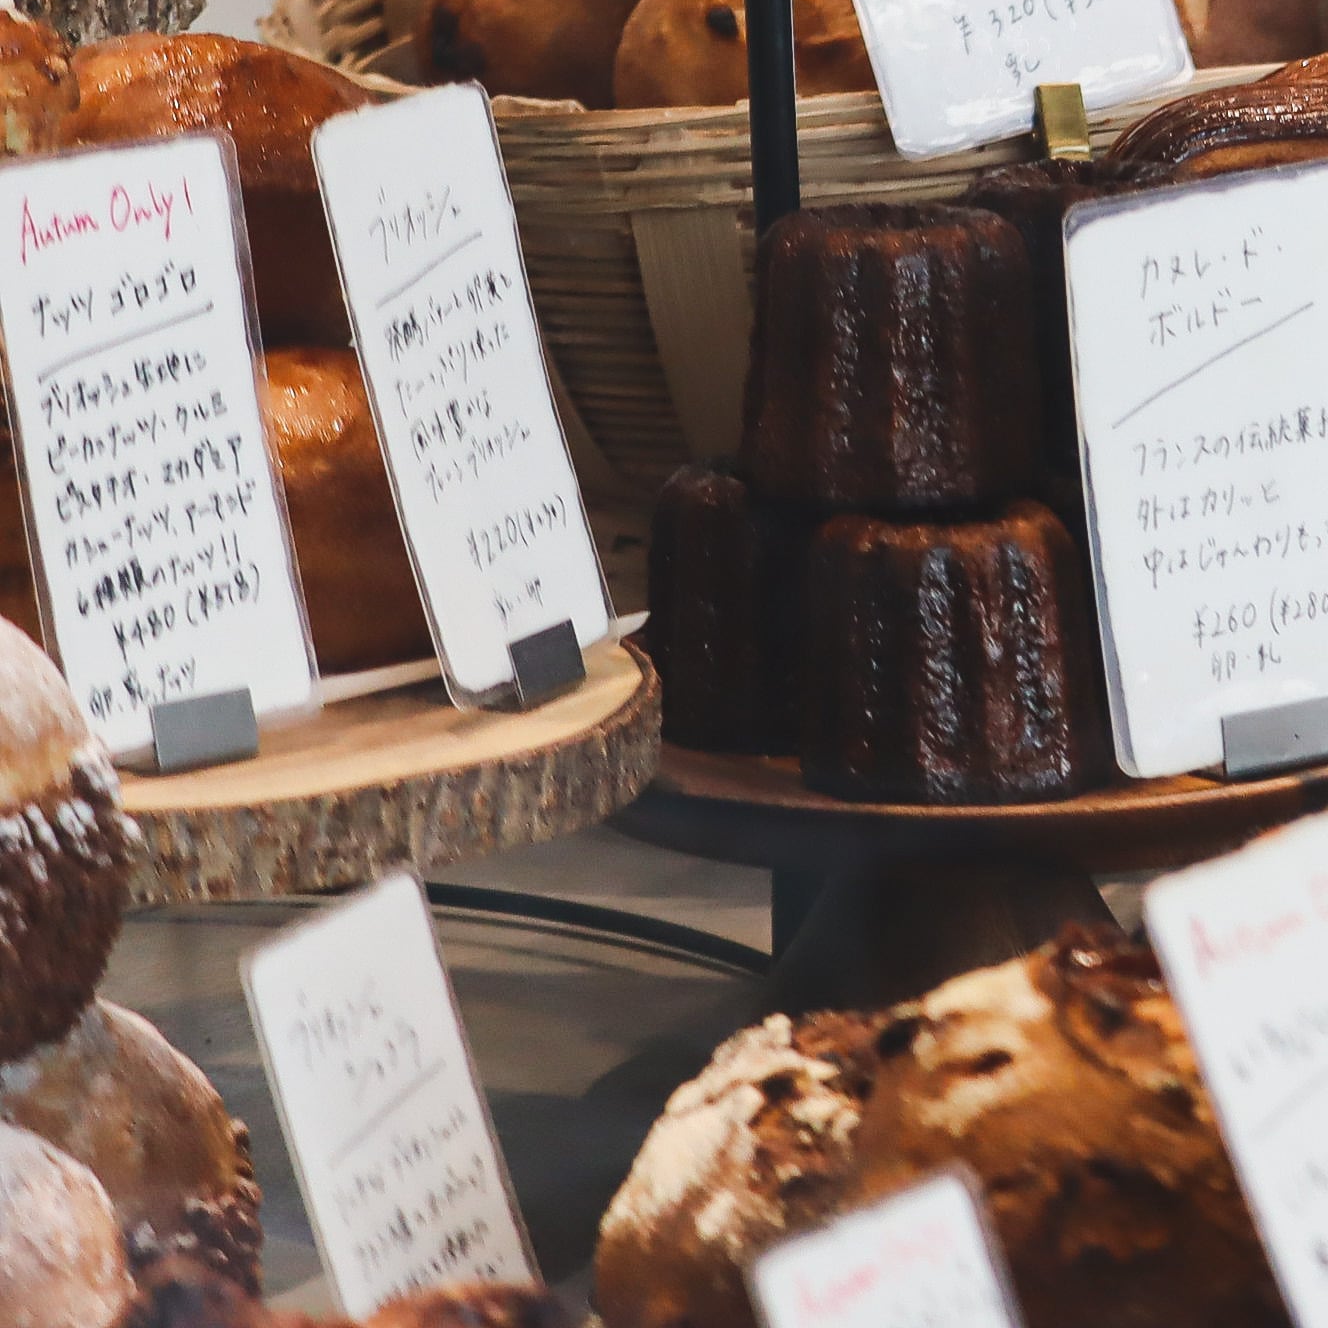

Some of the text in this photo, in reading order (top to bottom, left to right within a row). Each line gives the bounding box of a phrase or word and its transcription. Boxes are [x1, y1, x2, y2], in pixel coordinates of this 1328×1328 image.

[1149, 288, 1264, 349] ボルドー
[1137, 479, 1281, 532] 外はカリッと
